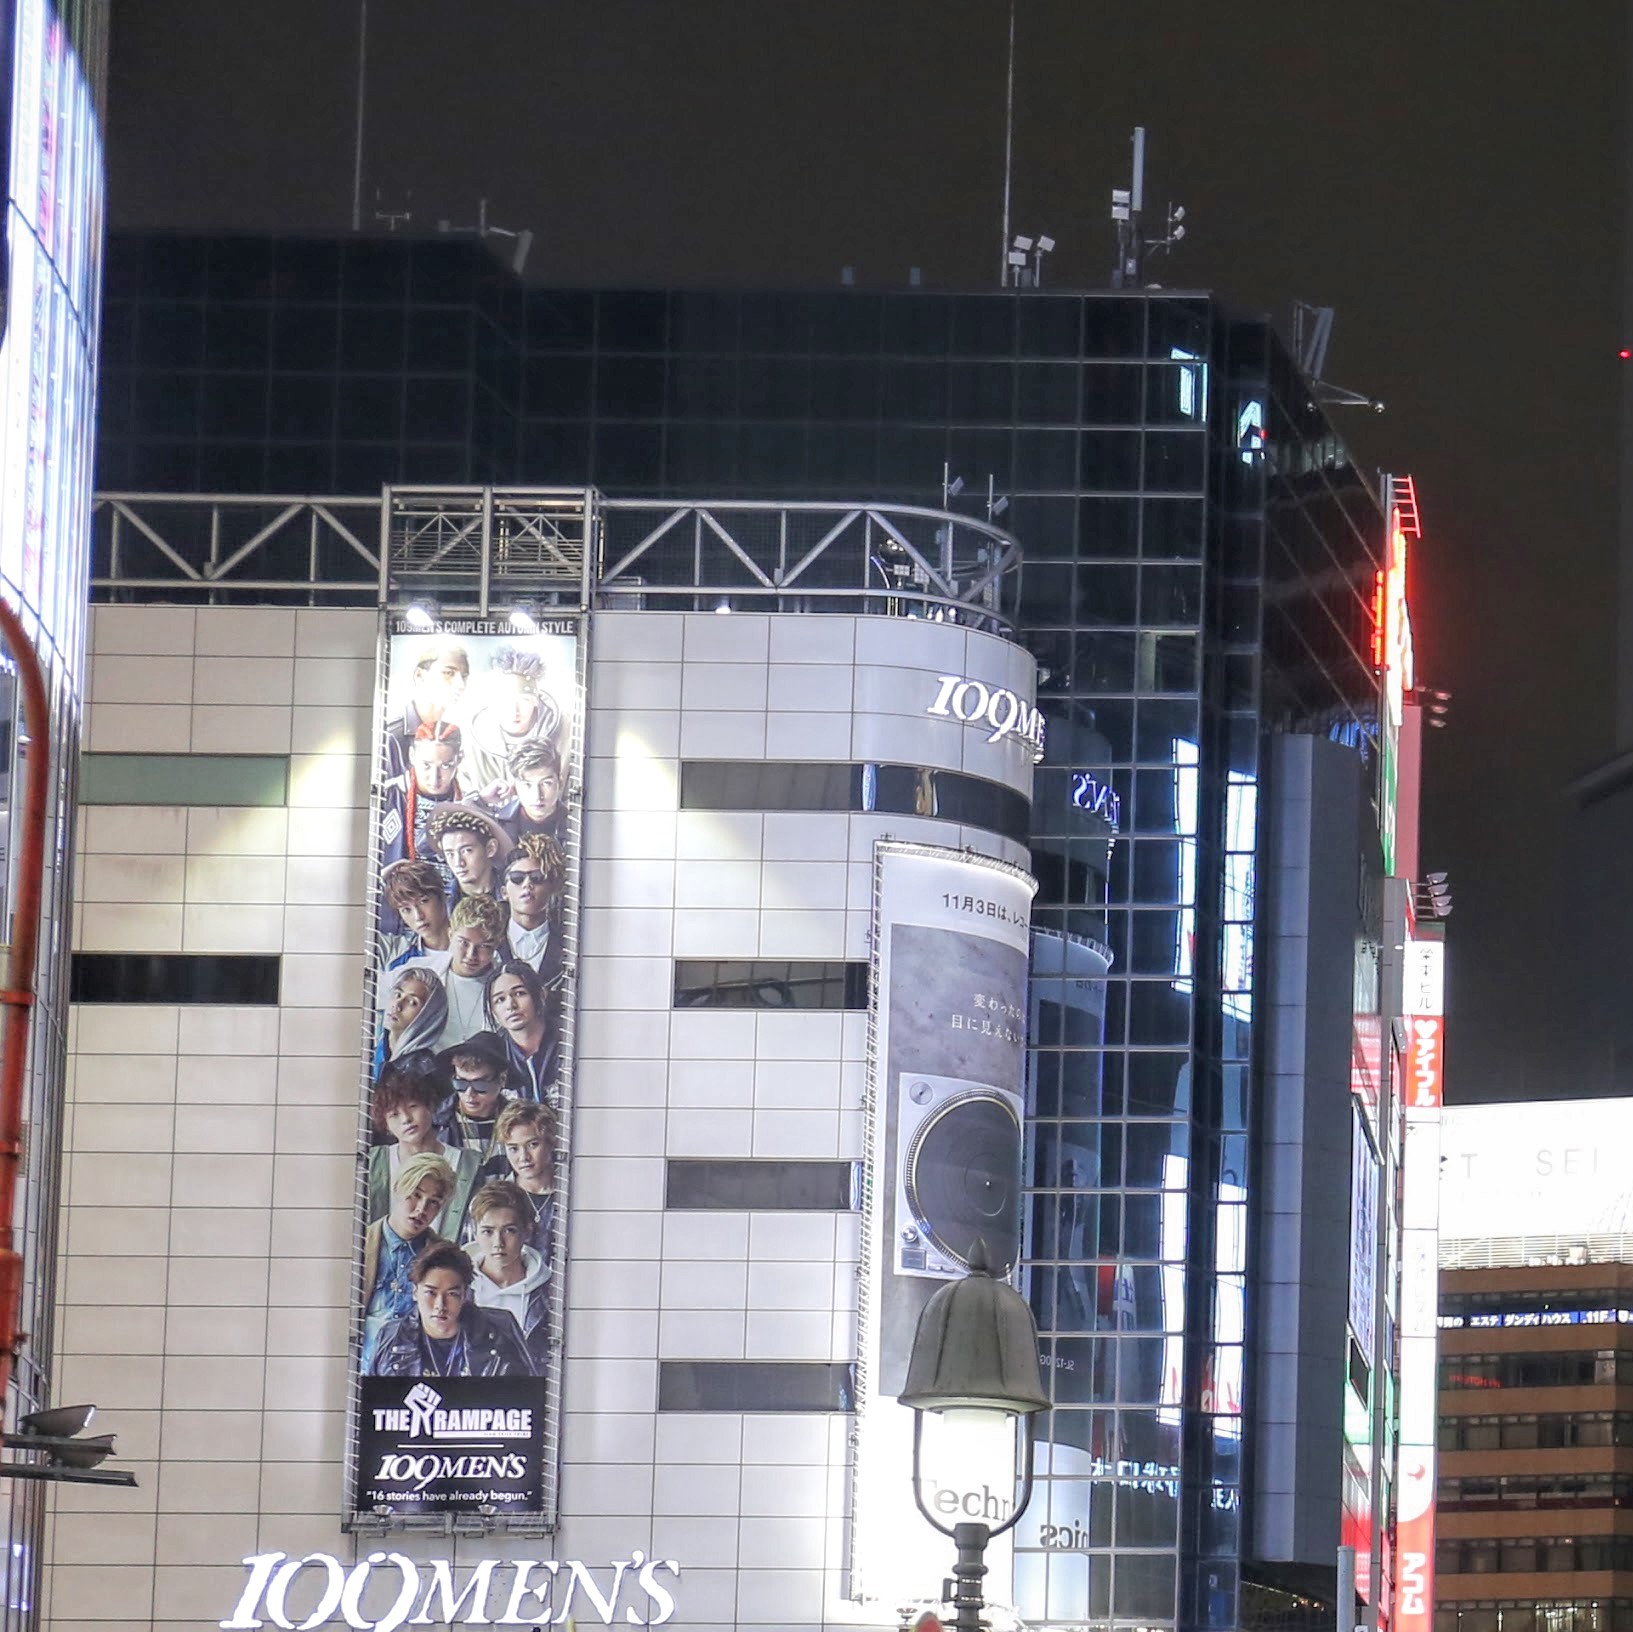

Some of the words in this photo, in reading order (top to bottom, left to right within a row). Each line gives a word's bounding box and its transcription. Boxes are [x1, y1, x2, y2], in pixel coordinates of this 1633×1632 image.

[444, 621, 496, 634] COMPLETE
[541, 620, 573, 634] STYLE
[1414, 1038, 1436, 1107] アイフル
[373, 1408, 411, 1432] THE
[433, 1408, 533, 1432] RAMPAGE
[374, 1453, 528, 1491] 109MEN'S
[386, 1491, 421, 1501] stories
[422, 1491, 448, 1501] have
[449, 1490, 488, 1503] already
[1402, 1551, 1426, 1615] アコム
